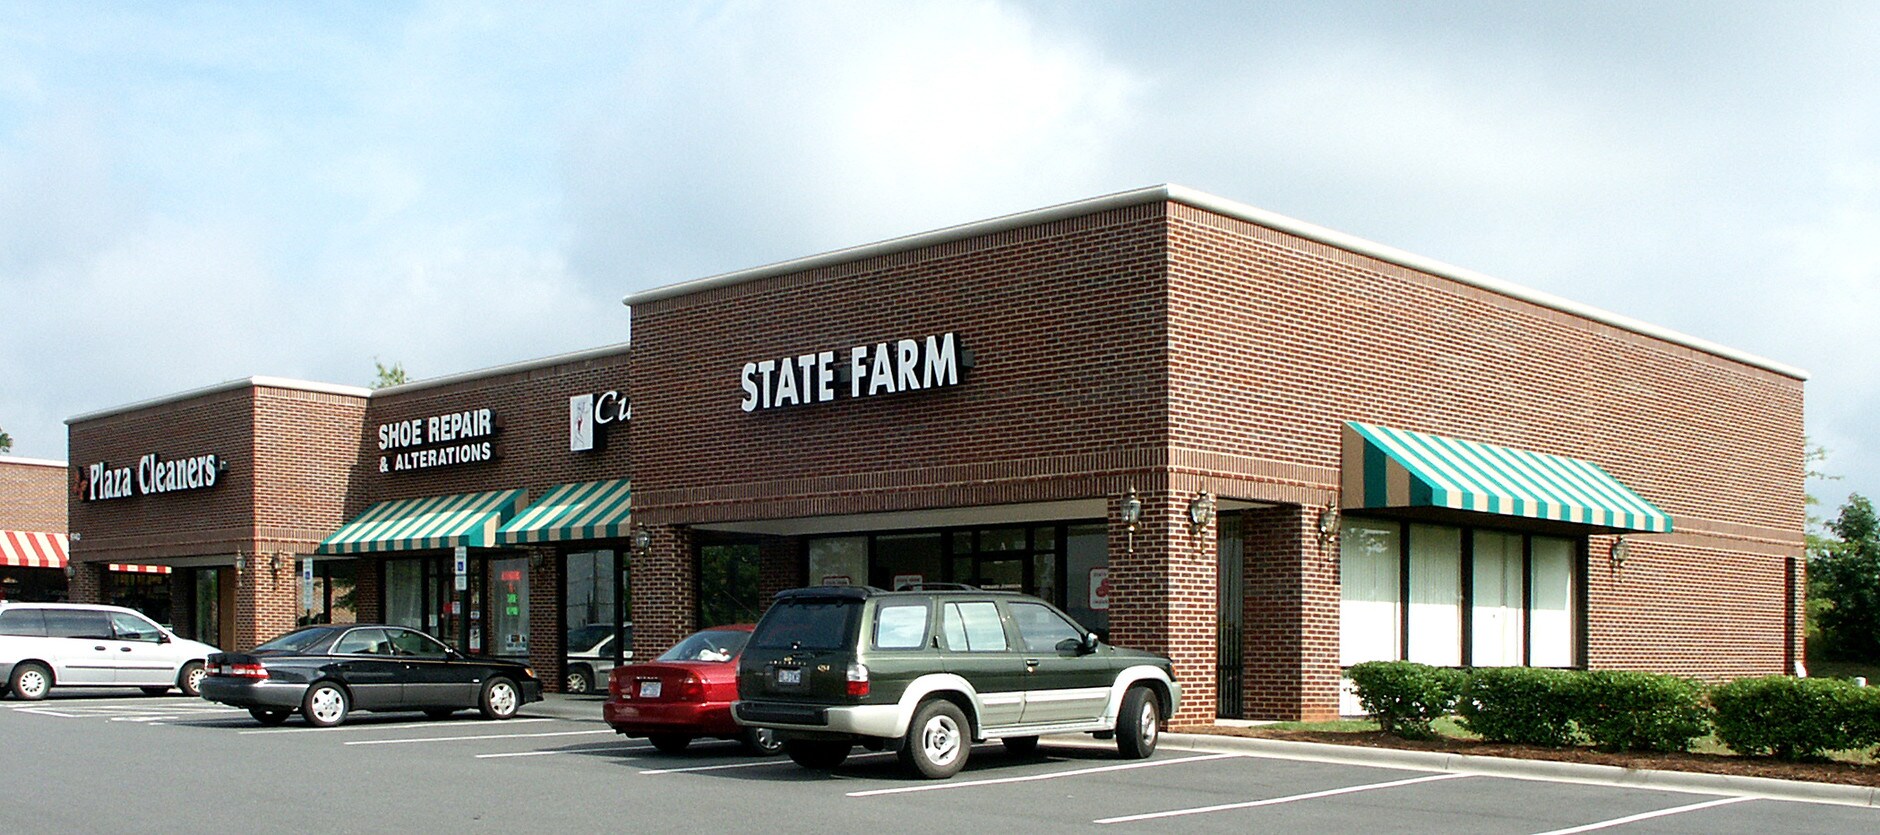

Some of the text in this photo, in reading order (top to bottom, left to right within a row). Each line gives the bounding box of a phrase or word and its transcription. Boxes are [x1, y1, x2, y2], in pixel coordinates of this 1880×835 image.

[741, 332, 958, 413] STATE FARM
[378, 408, 491, 450] SHOE REPAIR
[89, 453, 216, 500] Plaza Cleaners
[379, 442, 491, 473] & ALTERATIONS
